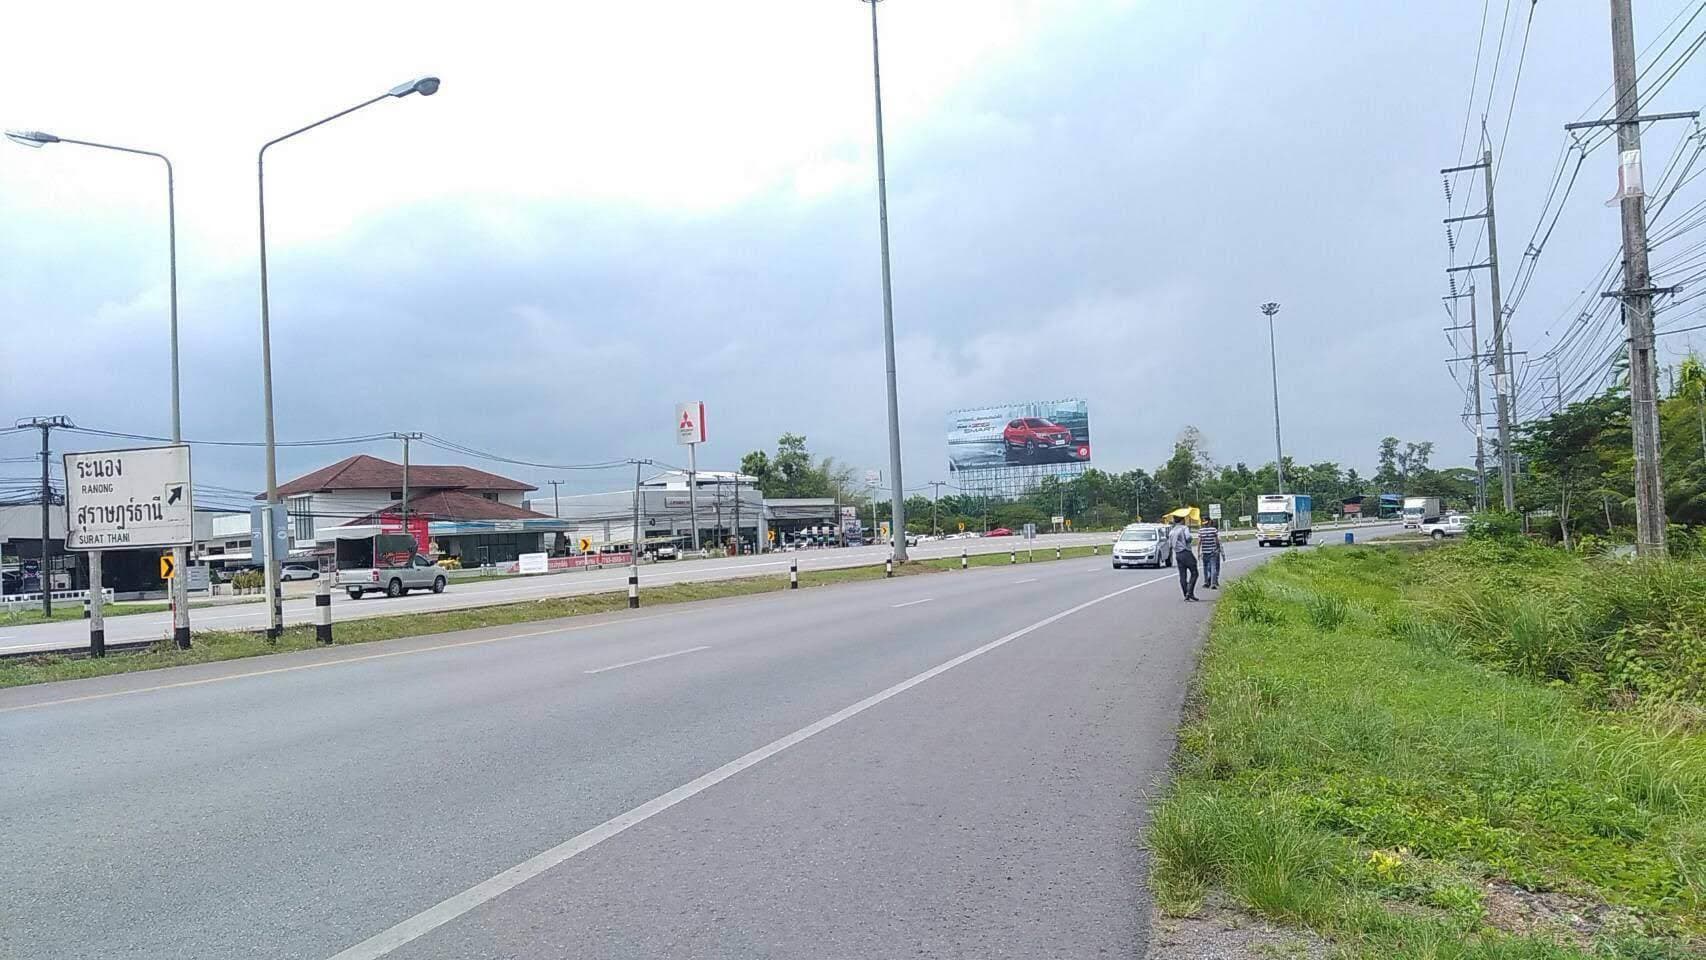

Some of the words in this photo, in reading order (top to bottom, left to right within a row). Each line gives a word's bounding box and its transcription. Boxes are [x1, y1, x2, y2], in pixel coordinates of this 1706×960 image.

[77, 459, 122, 478] ระนอง
[81, 484, 114, 494] RANONG
[78, 496, 163, 533] สุราษฎร์ธานี
[79, 534, 104, 544] SURAT
[107, 533, 130, 543] THANI
